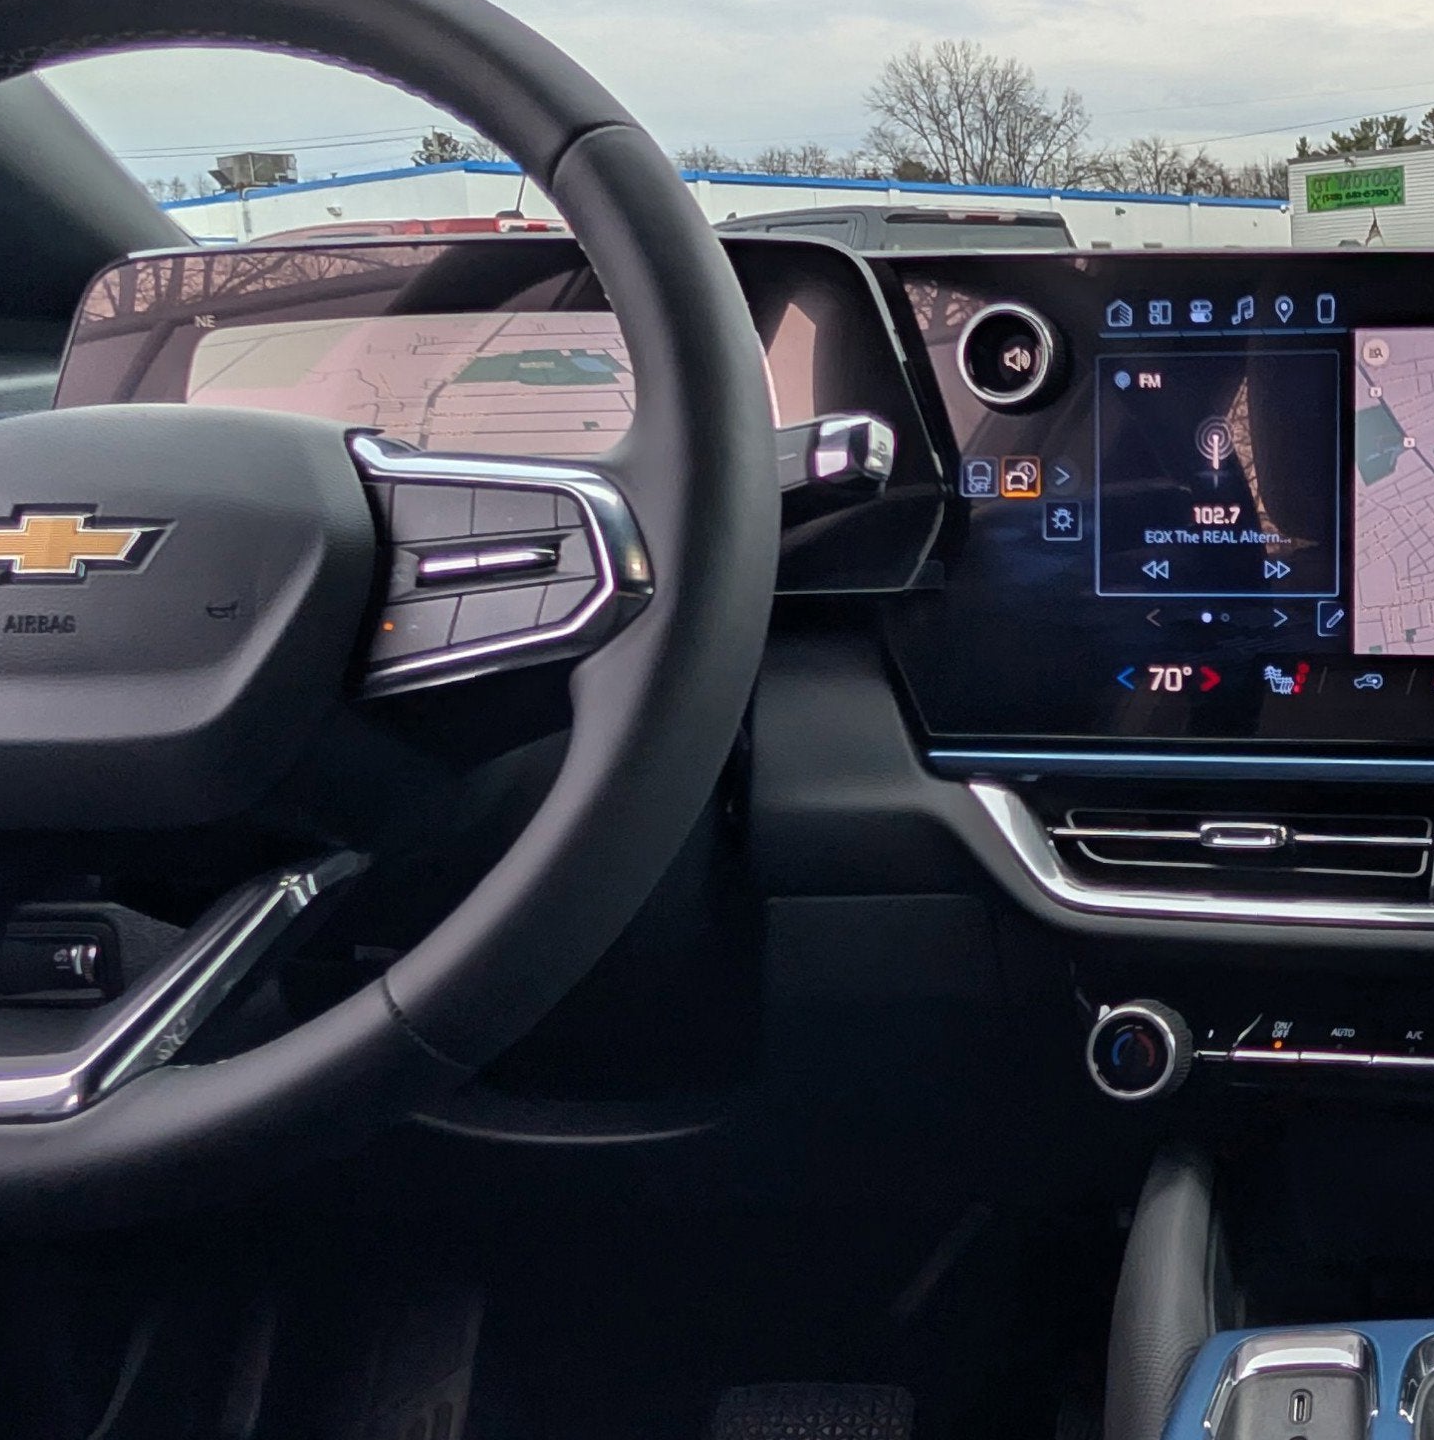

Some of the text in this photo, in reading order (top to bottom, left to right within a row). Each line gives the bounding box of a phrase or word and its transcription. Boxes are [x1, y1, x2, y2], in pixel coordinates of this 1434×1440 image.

[194, 314, 216, 328] NE
[1138, 372, 1161, 389] FM
[1193, 506, 1241, 524] 102.7
[1144, 529, 1173, 544] EQX
[1175, 529, 1199, 544] The
[1203, 530, 1238, 544] REAL
[3, 615, 76, 634] AIRBAG
[1148, 665, 1193, 692] 70°
[1271, 1029, 1290, 1039] OFF
[1330, 1028, 1356, 1038] AUTO
[1405, 1030, 1424, 1040] A/C
